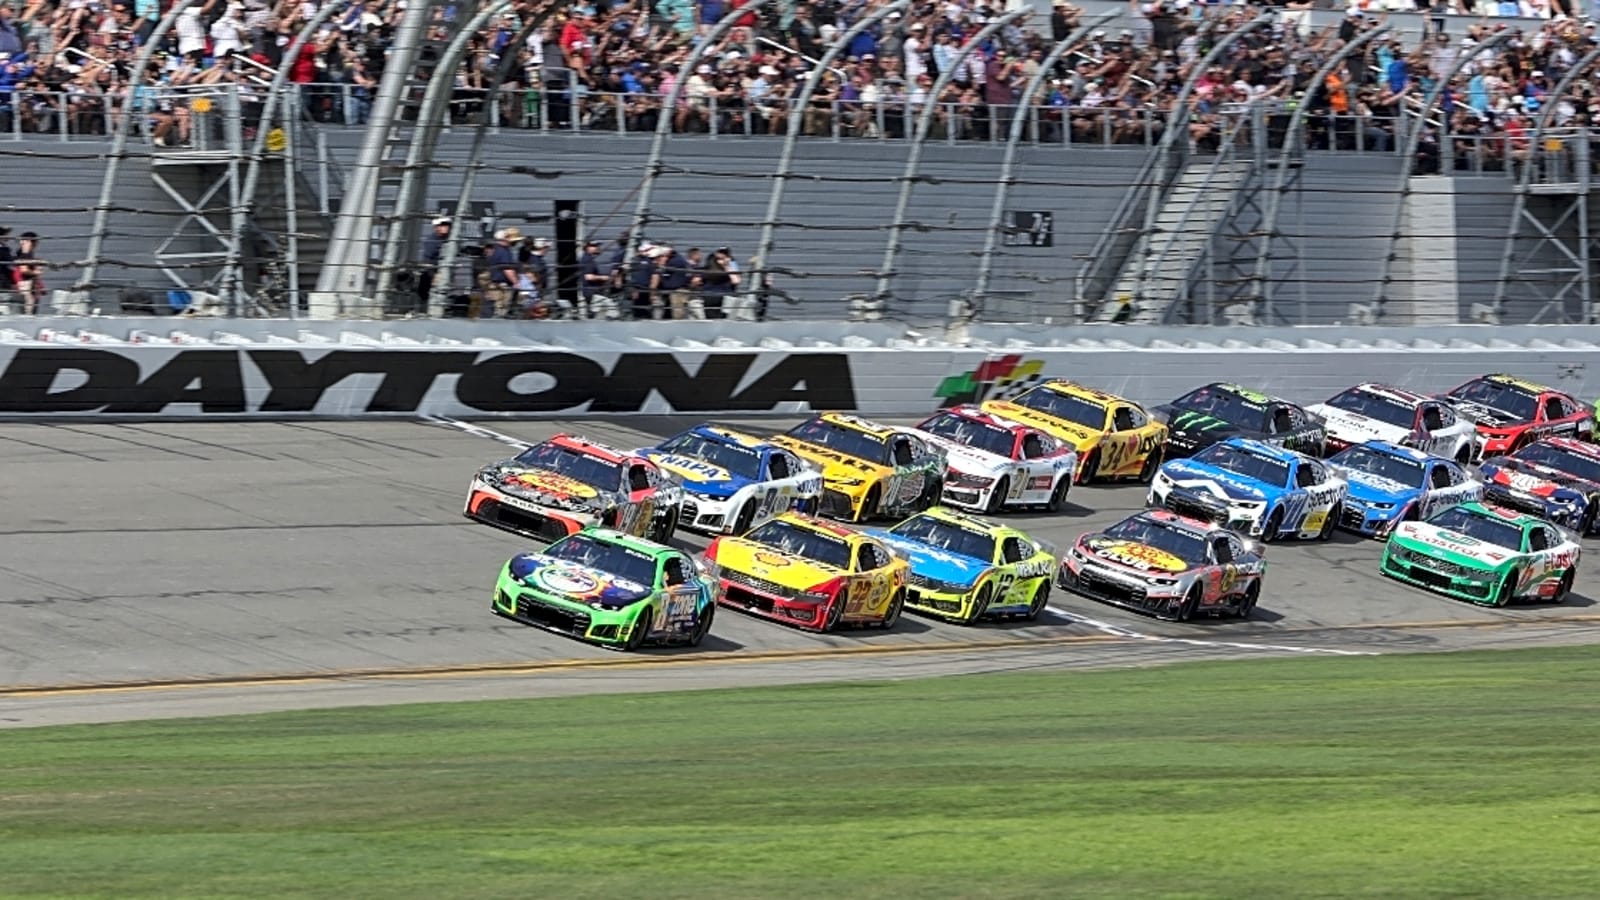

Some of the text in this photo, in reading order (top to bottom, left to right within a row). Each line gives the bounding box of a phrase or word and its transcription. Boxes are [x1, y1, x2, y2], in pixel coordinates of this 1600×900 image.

[0, 348, 858, 414] DAYTONA
[660, 453, 722, 479] NAPA
[1412, 532, 1482, 557] Castrol
